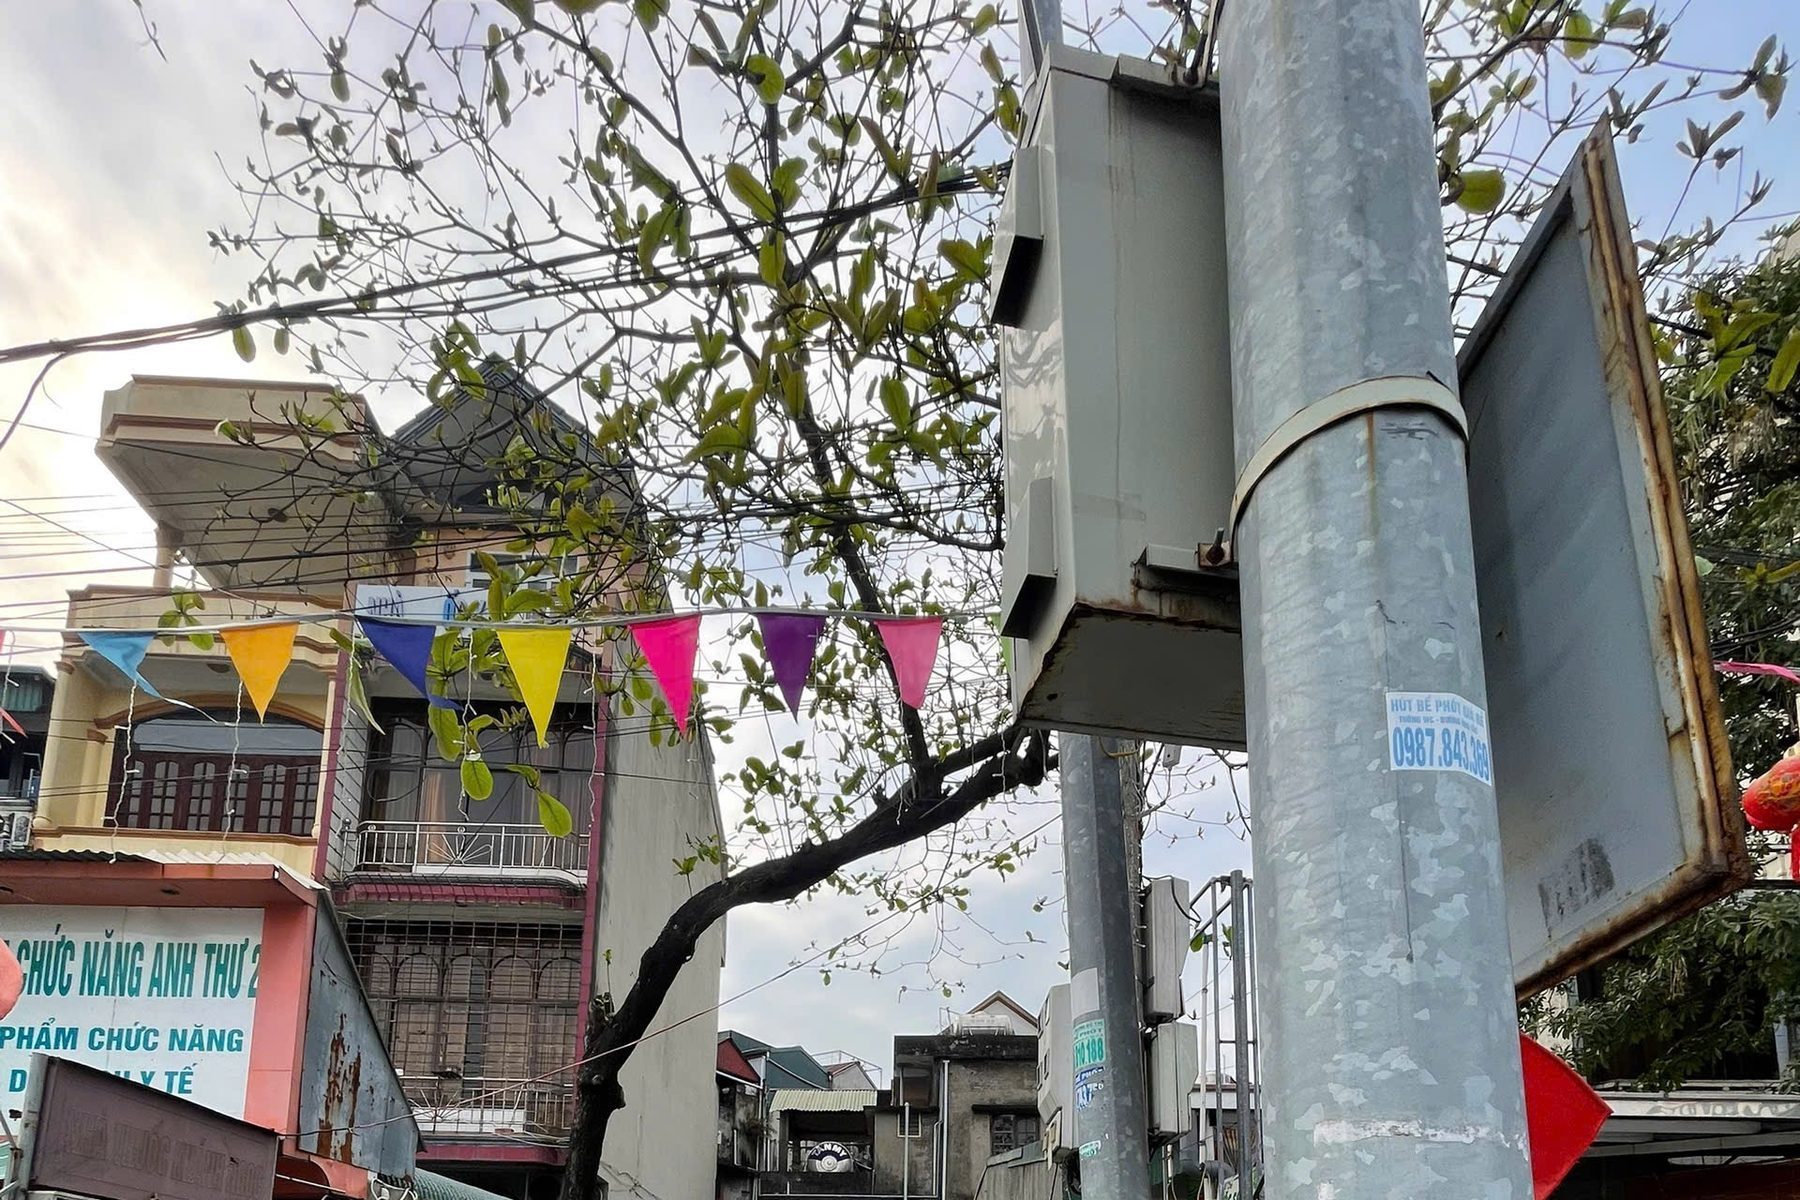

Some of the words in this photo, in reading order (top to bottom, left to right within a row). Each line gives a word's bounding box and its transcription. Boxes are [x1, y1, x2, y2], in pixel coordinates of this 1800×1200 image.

[17, 923, 76, 997] CHỨC
[79, 928, 145, 998] NĂNG
[147, 942, 198, 998] ANH
[202, 937, 250, 999] THƯ
[247, 943, 262, 999] 2
[0, 1016, 79, 1051] PHẨM
[87, 1021, 160, 1052] CHỨC
[168, 1023, 244, 1052] NĂNG
[164, 1062, 199, 1095] TẾ
